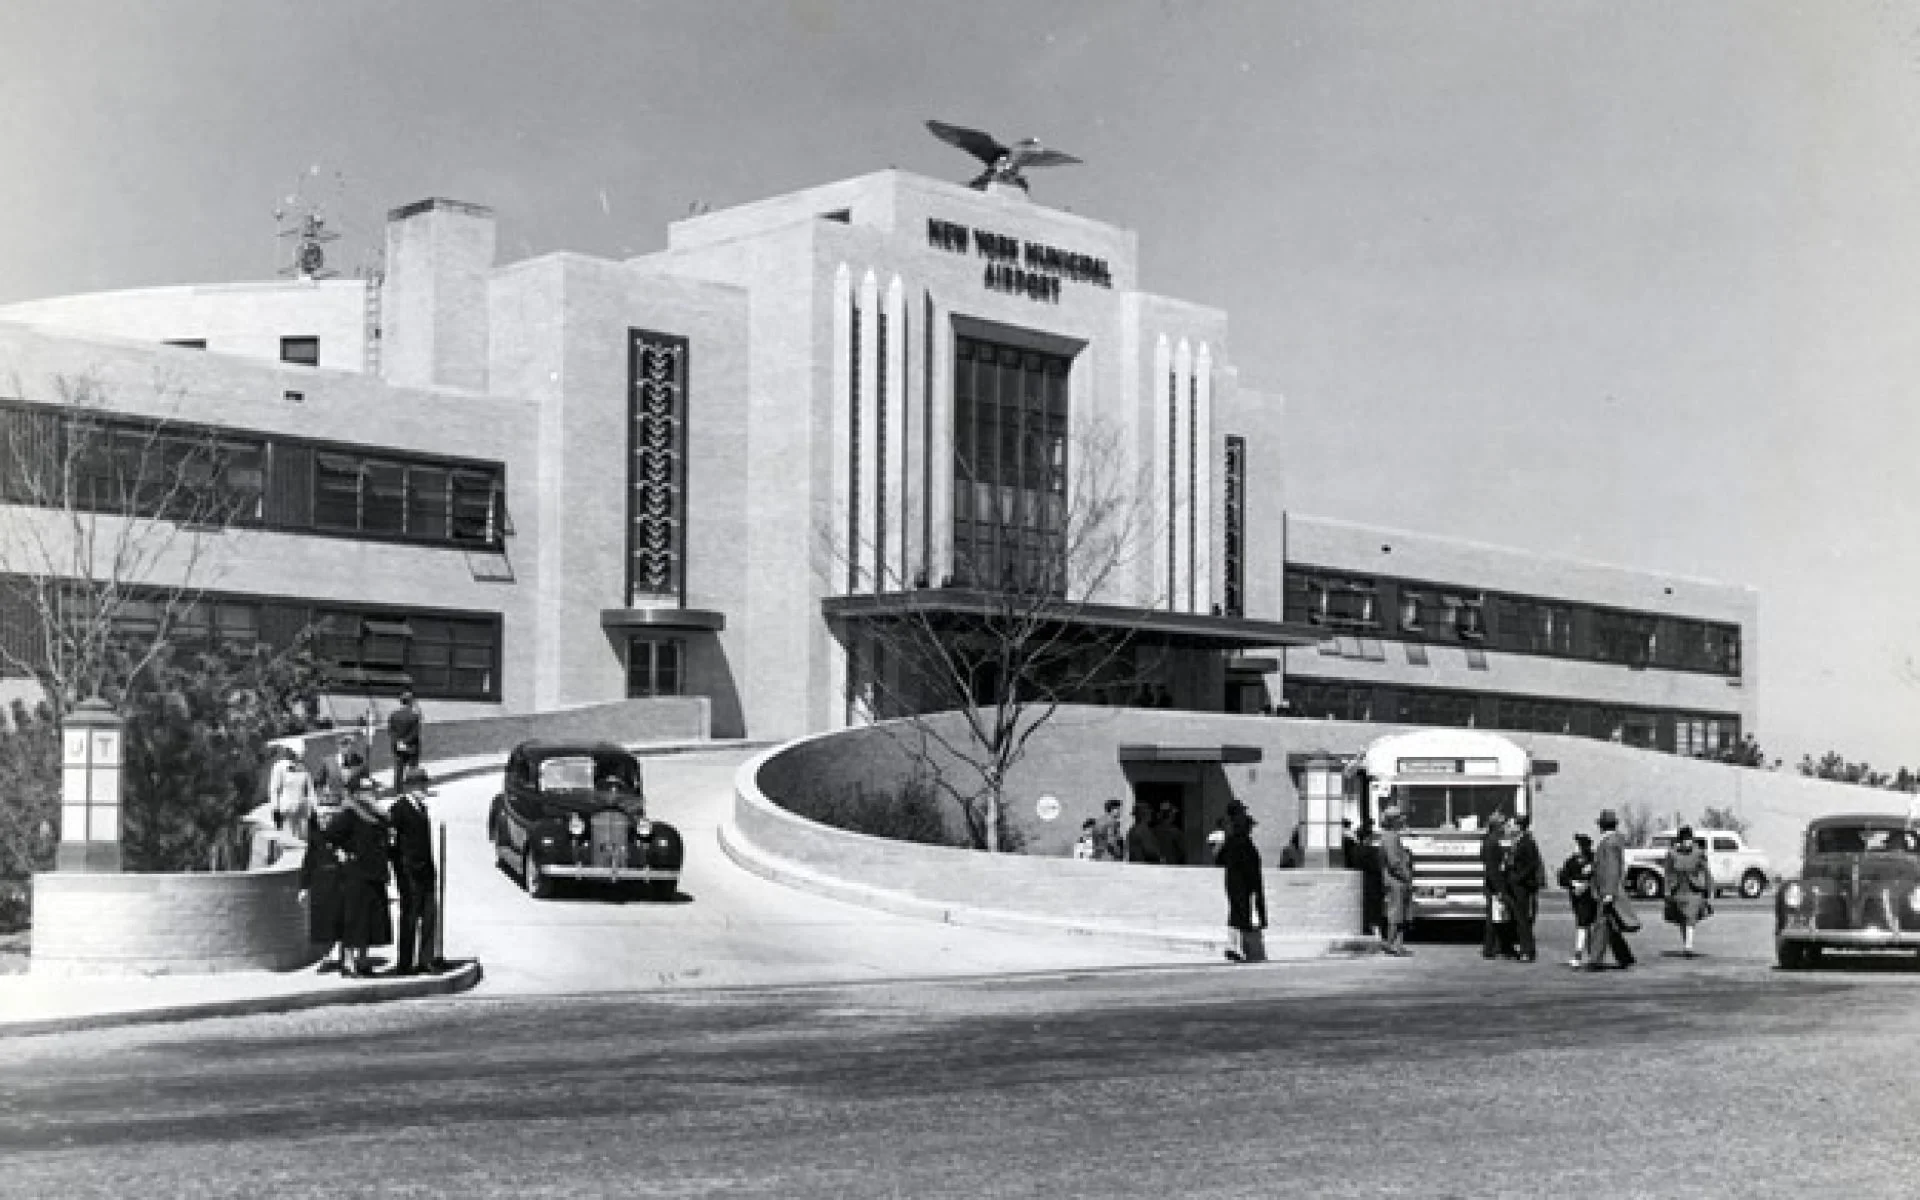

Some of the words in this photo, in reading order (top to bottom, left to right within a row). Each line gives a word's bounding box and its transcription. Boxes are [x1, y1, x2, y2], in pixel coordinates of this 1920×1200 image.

[928, 218, 970, 254] NEW
[1024, 240, 1112, 288] MUNICIPAL
[985, 261, 1061, 304] AIRPORT
